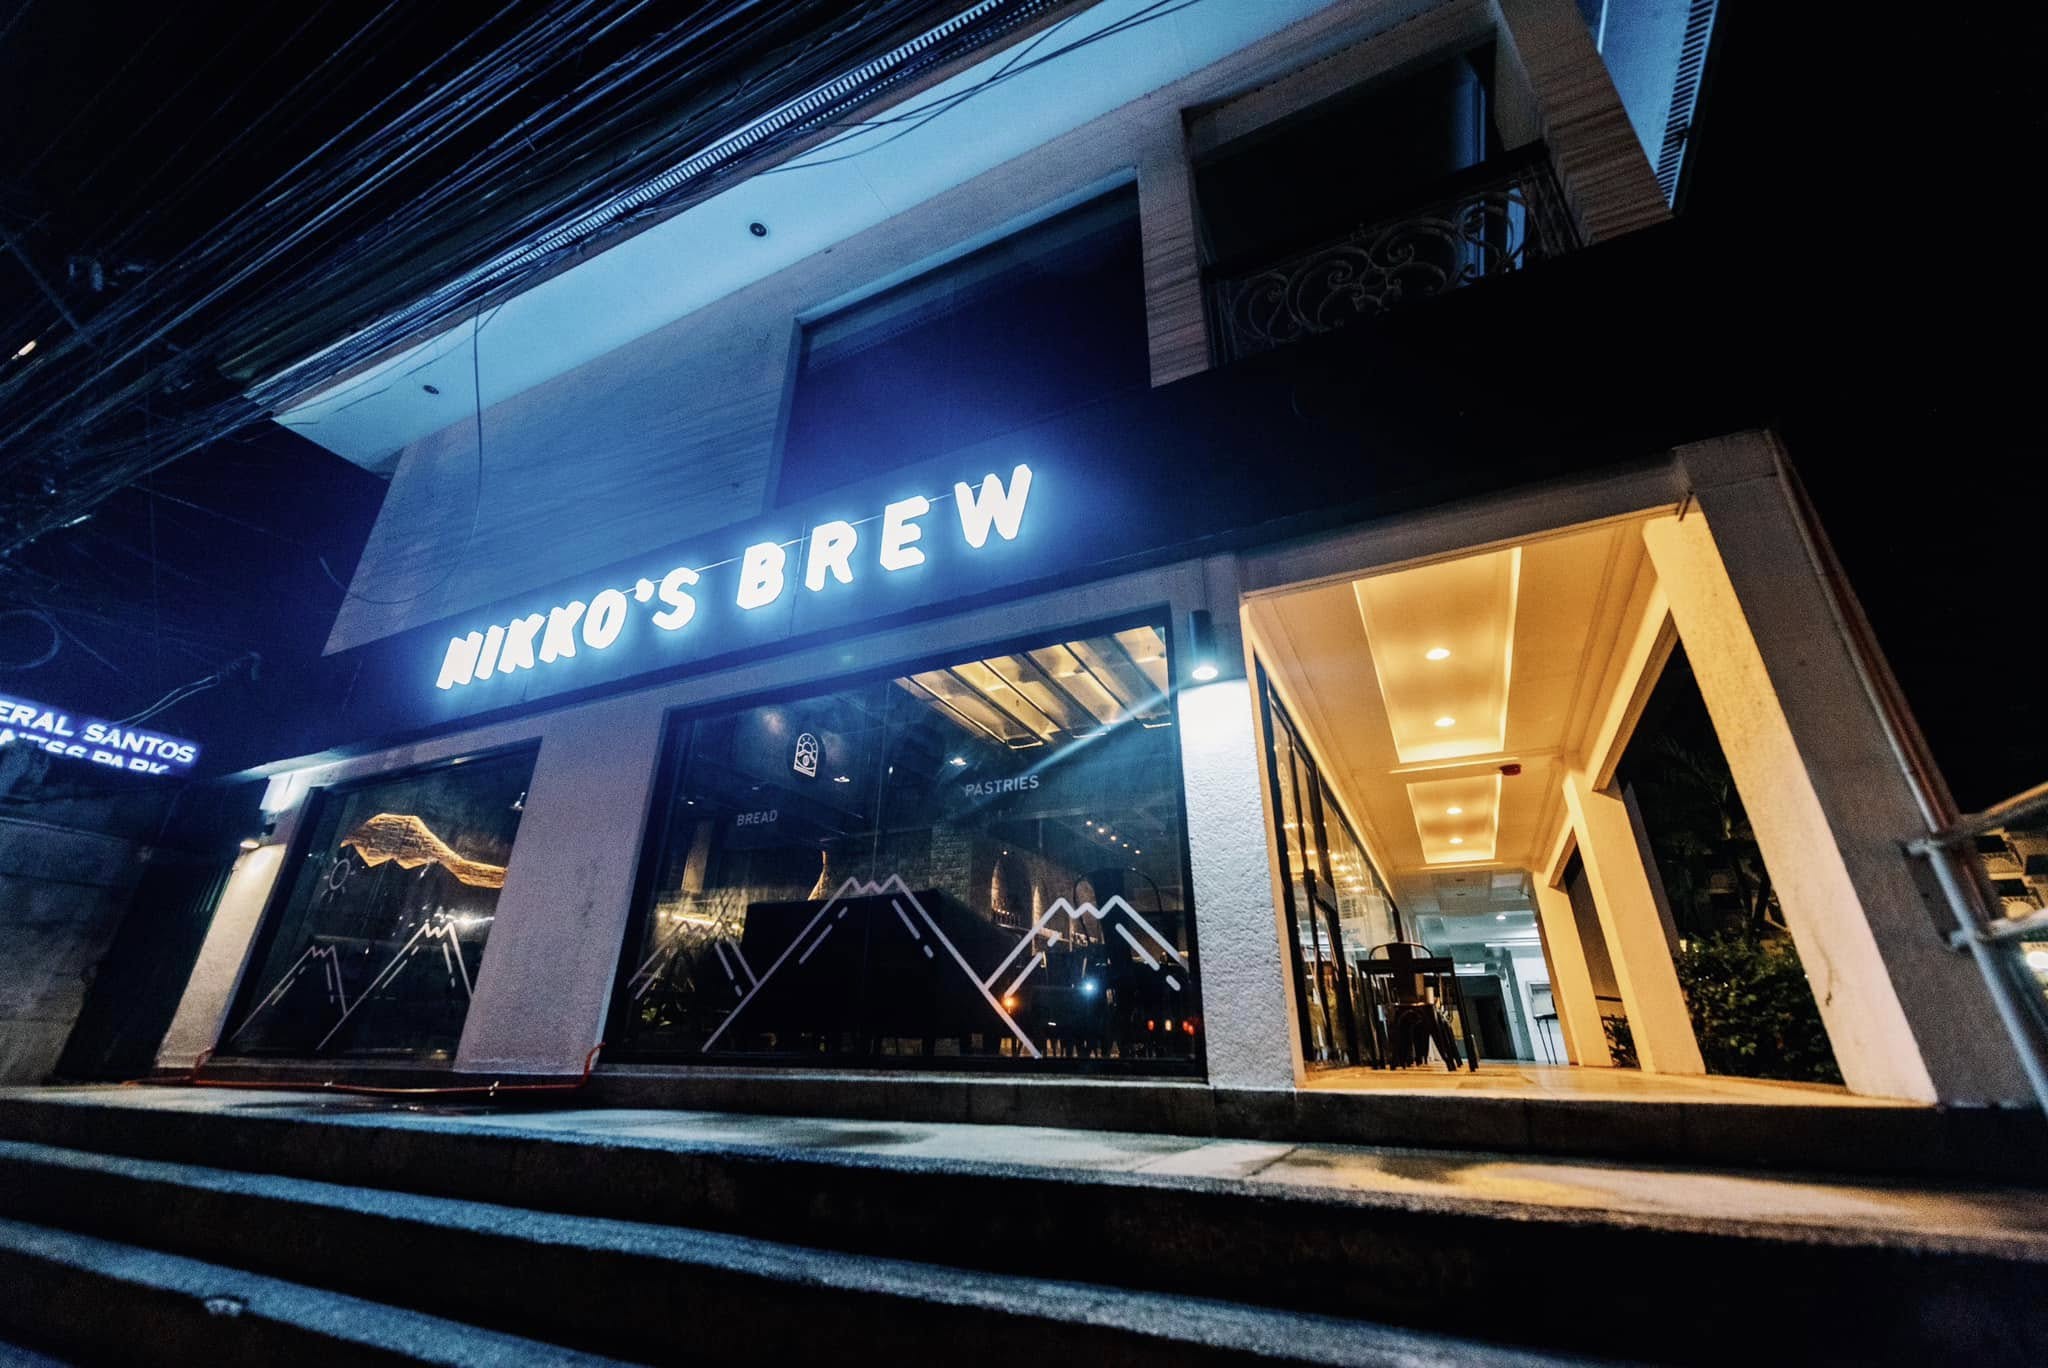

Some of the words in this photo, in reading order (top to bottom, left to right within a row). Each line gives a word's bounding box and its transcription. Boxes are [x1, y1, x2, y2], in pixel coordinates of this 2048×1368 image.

[436, 567, 700, 690] NIKKO'S
[735, 463, 1033, 610] BREW
[83, 723, 197, 763] SANTOS
[964, 774, 1040, 798] PASTRIES
[736, 809, 779, 827] BREAD
